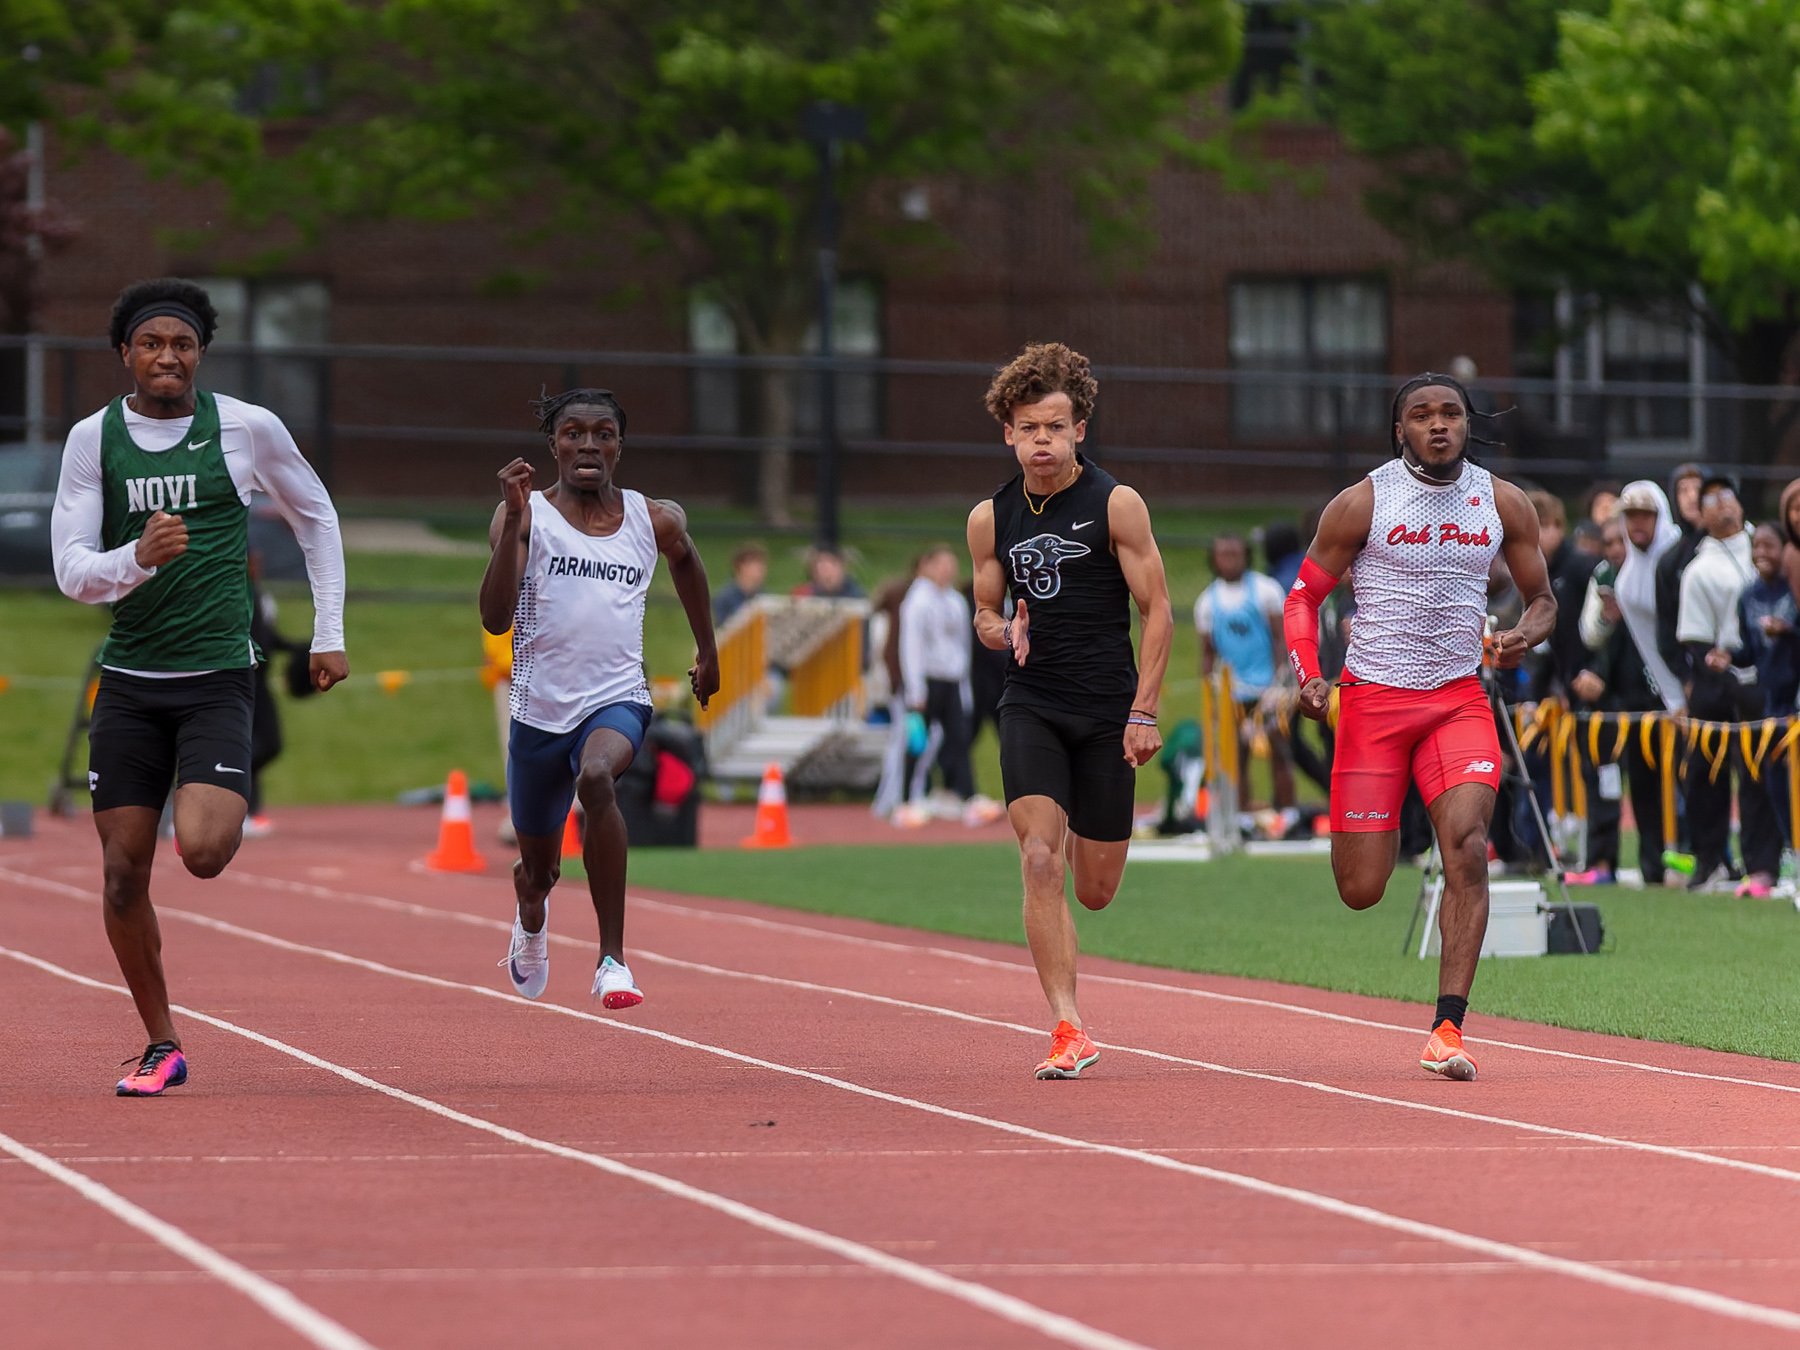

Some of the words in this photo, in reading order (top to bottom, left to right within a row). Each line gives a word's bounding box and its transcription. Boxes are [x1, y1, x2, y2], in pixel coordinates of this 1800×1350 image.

[126, 474, 198, 513] NOVI
[1387, 523, 1432, 546] Oak
[1439, 523, 1491, 547] Park
[547, 555, 646, 588] FARMINGTON
[1345, 811, 1364, 820] Oak
[1367, 811, 1390, 820] Park
